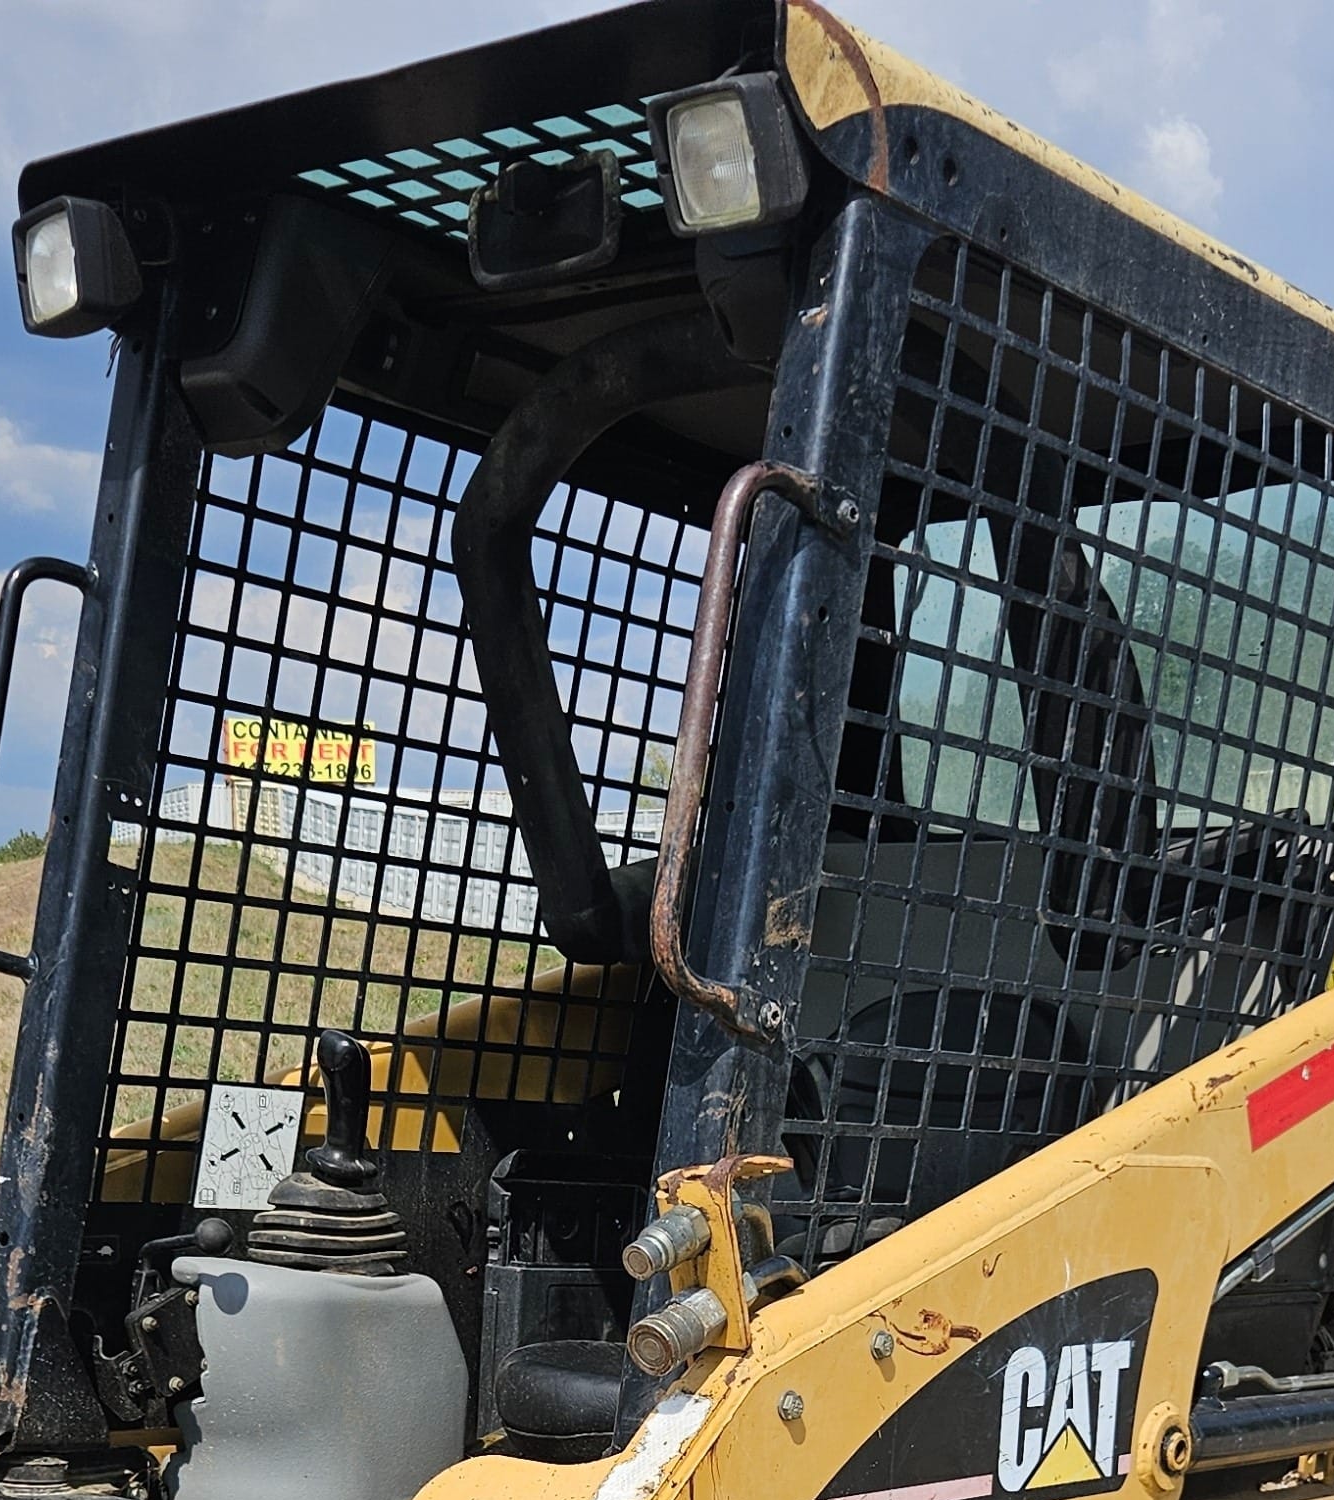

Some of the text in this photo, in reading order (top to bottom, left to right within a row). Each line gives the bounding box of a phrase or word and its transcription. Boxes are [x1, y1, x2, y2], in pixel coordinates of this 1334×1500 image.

[233, 720, 371, 742] CONTANE
[233, 742, 290, 761] FOR
[235, 761, 372, 780] 7-23-186
[997, 1340, 1132, 1493] CAT
